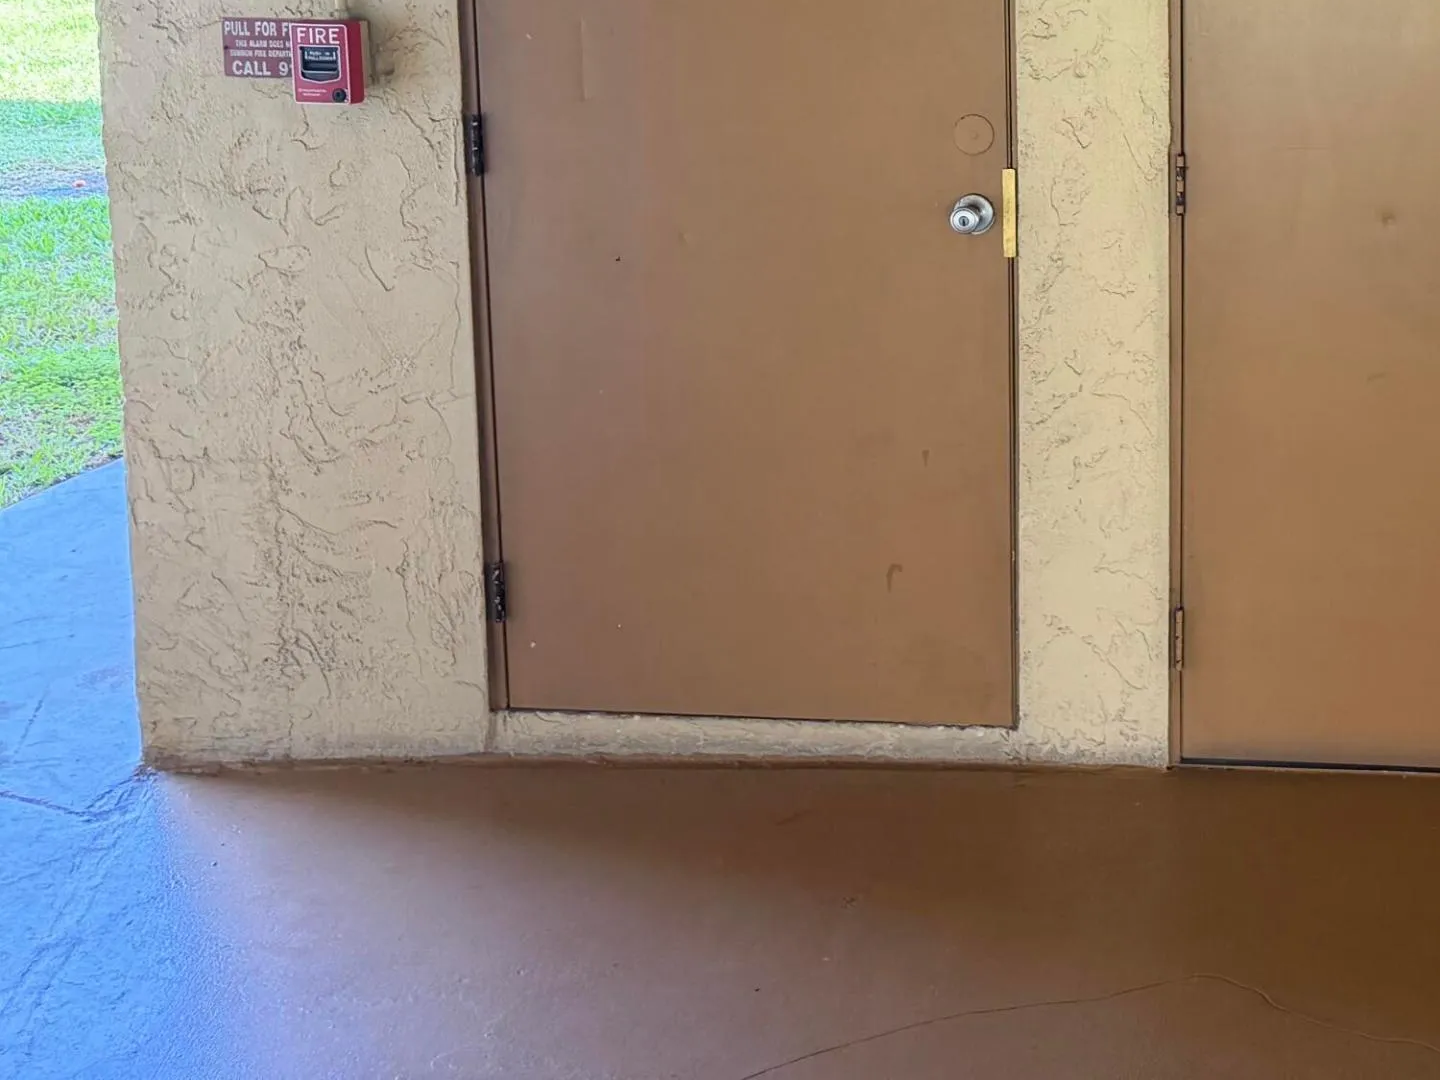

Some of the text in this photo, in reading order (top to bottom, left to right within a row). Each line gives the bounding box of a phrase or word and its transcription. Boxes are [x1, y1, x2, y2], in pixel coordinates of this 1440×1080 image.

[224, 21, 250, 36] PULL
[254, 22, 277, 37] FOR
[297, 27, 340, 44] FIRE
[232, 60, 272, 76] CALL
